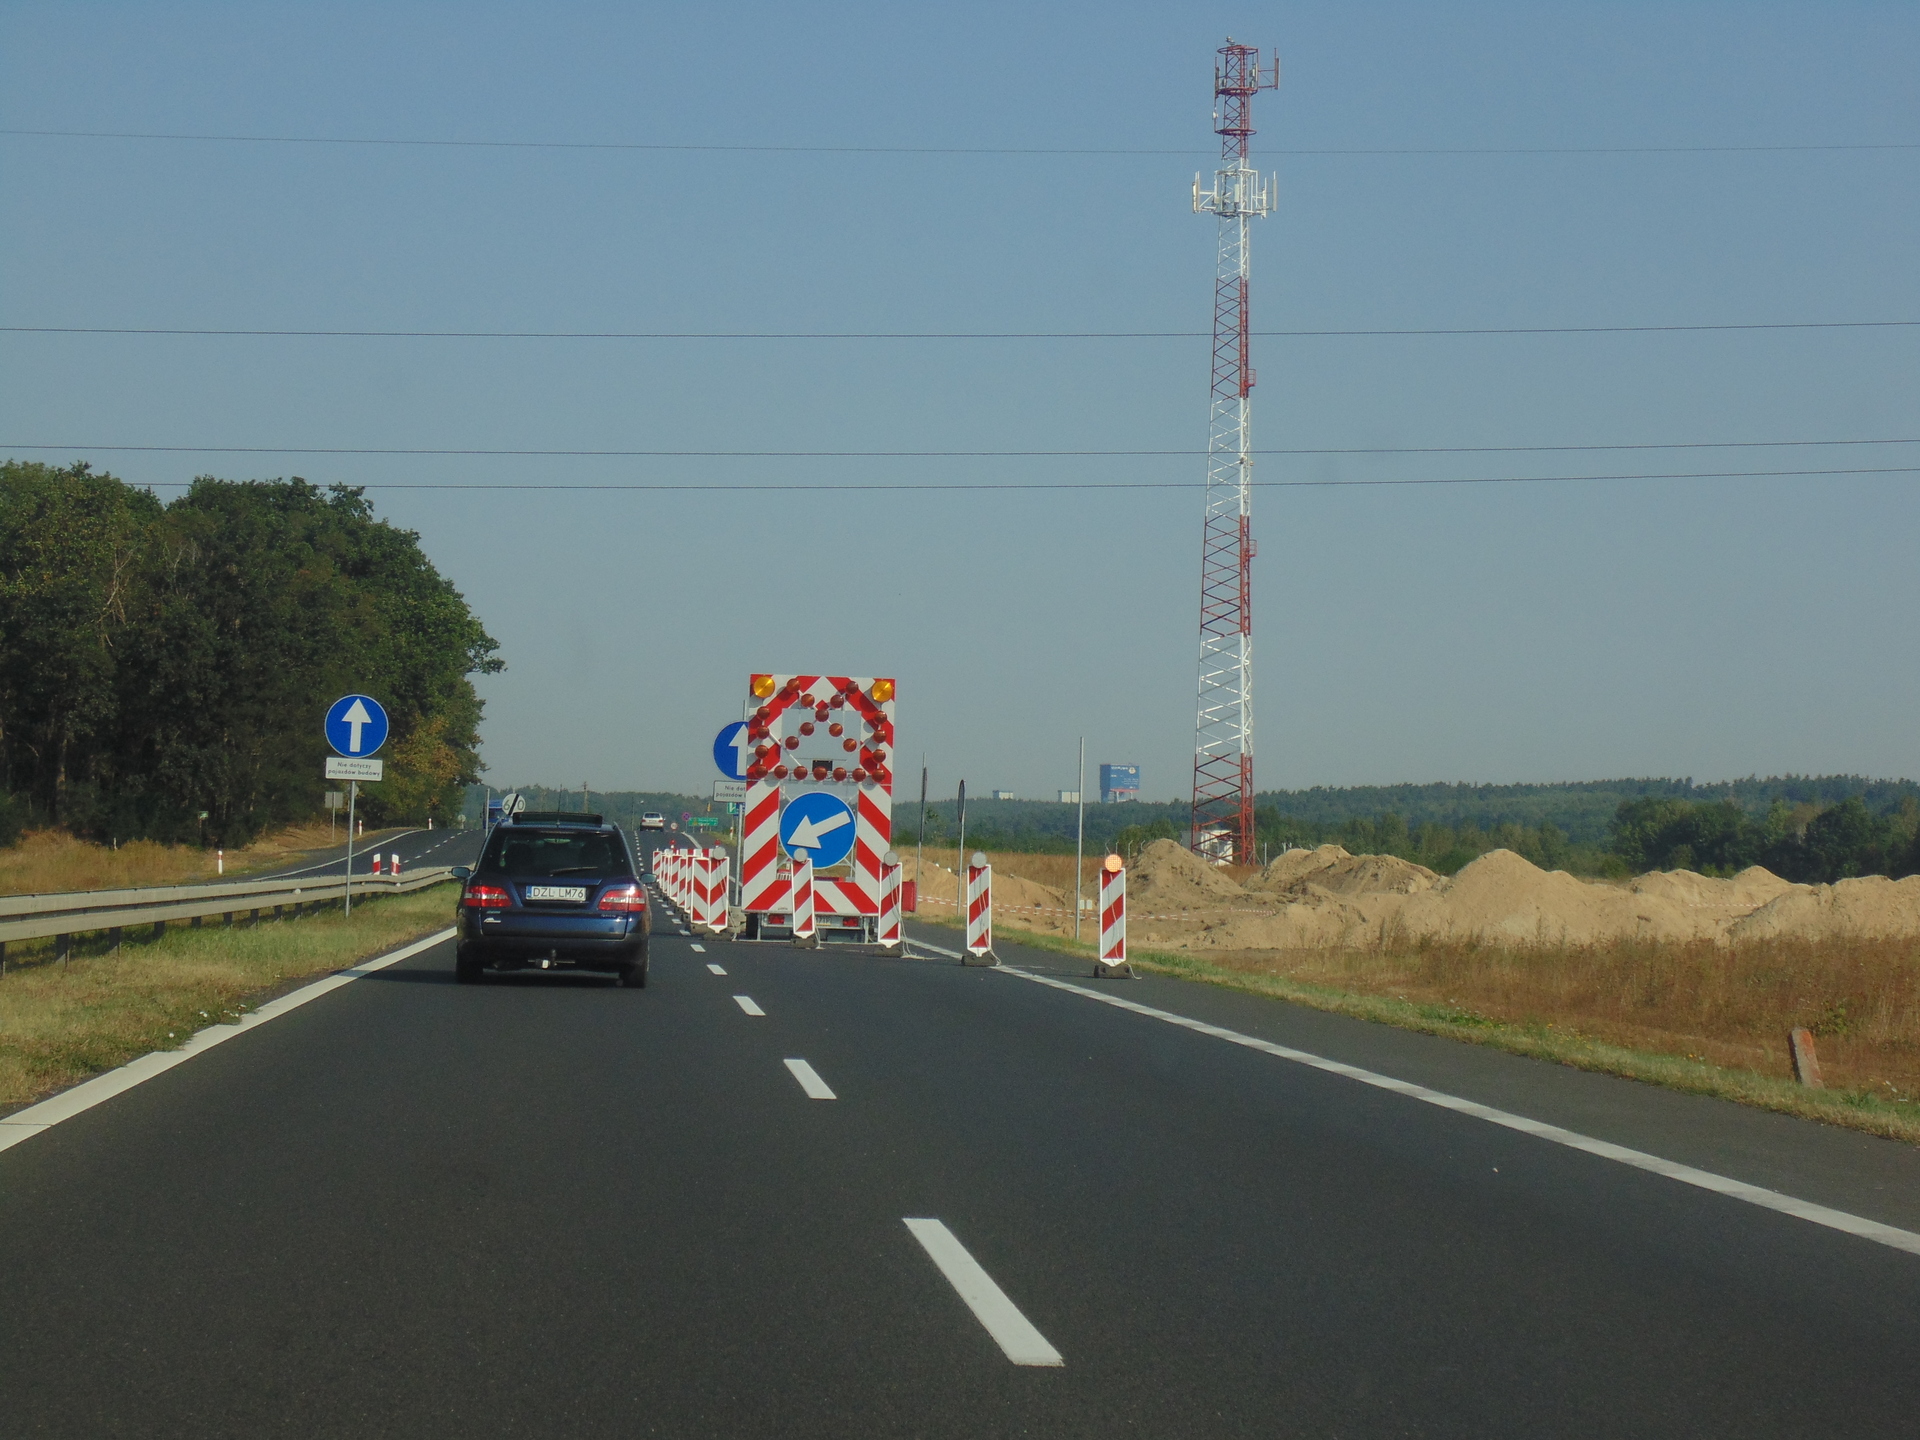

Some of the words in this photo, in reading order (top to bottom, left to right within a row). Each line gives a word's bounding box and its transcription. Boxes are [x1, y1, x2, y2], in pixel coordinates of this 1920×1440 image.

[503, 799, 525, 811] 60
[533, 887, 555, 898] DZL
[558, 888, 584, 899] LM76
